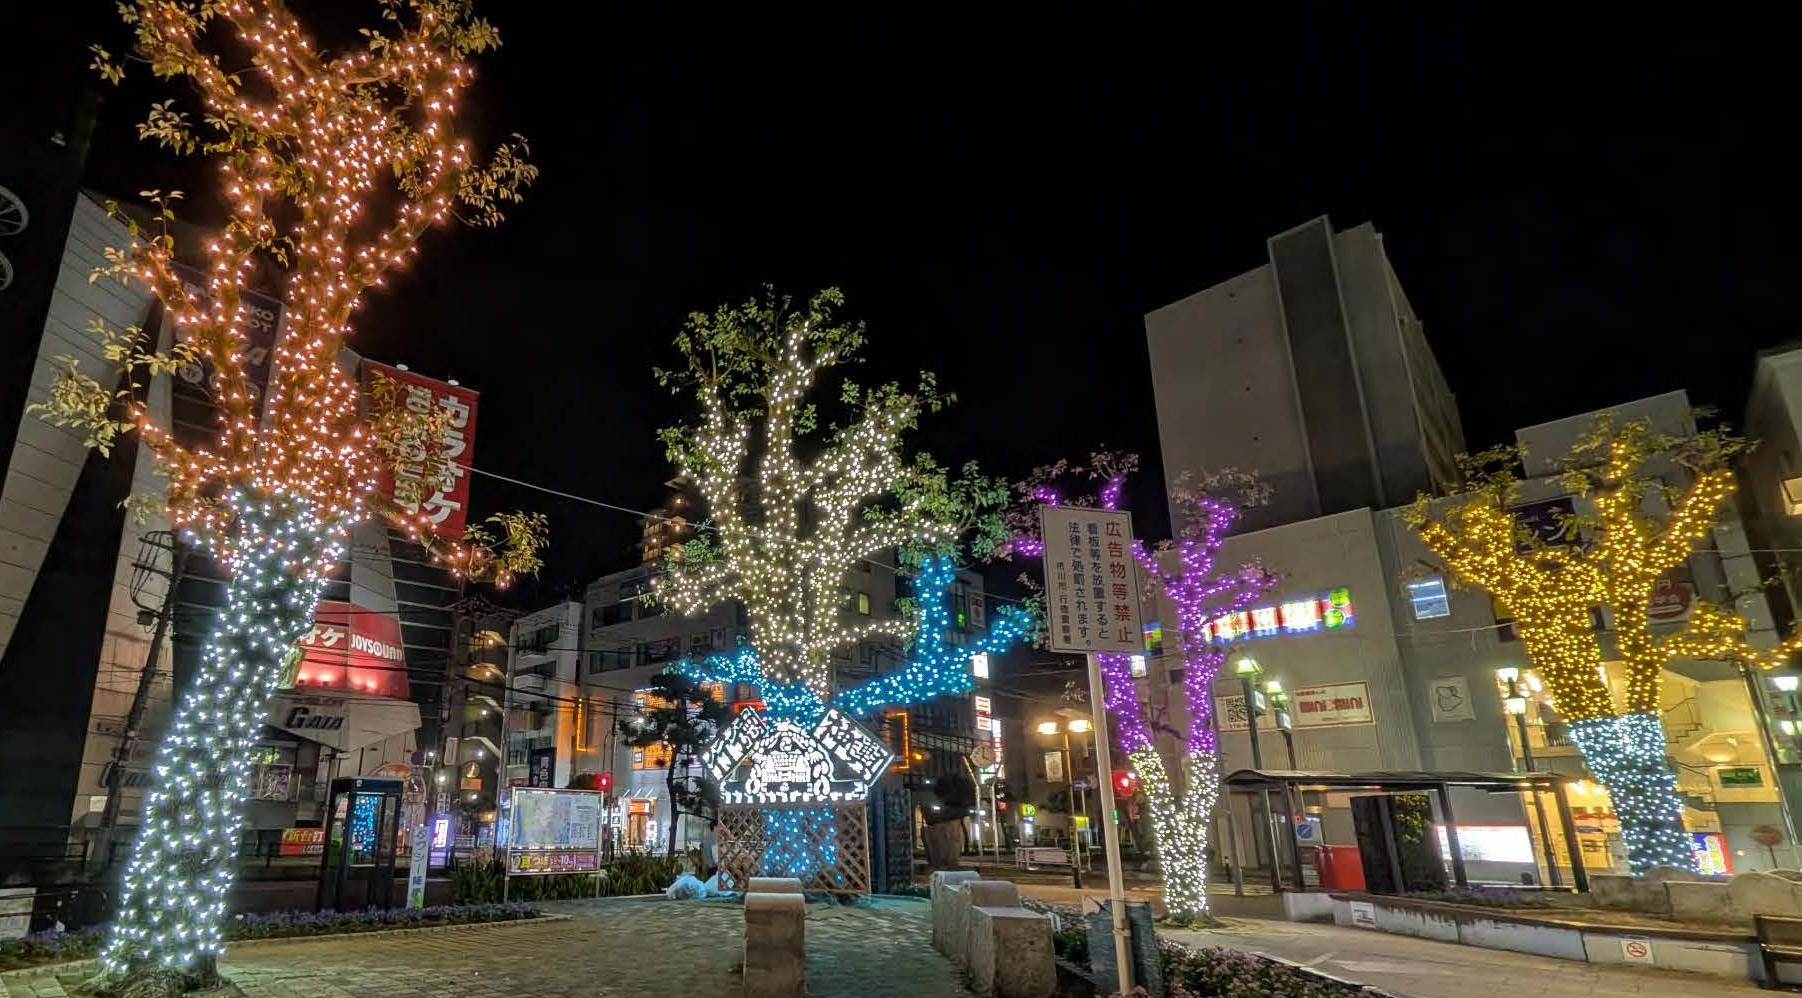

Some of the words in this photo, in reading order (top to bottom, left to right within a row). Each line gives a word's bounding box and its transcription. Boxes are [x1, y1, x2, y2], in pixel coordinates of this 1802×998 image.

[1086, 522, 1111, 640] 看板等を放置すると
[1105, 521, 1134, 644] 広告物等禁止
